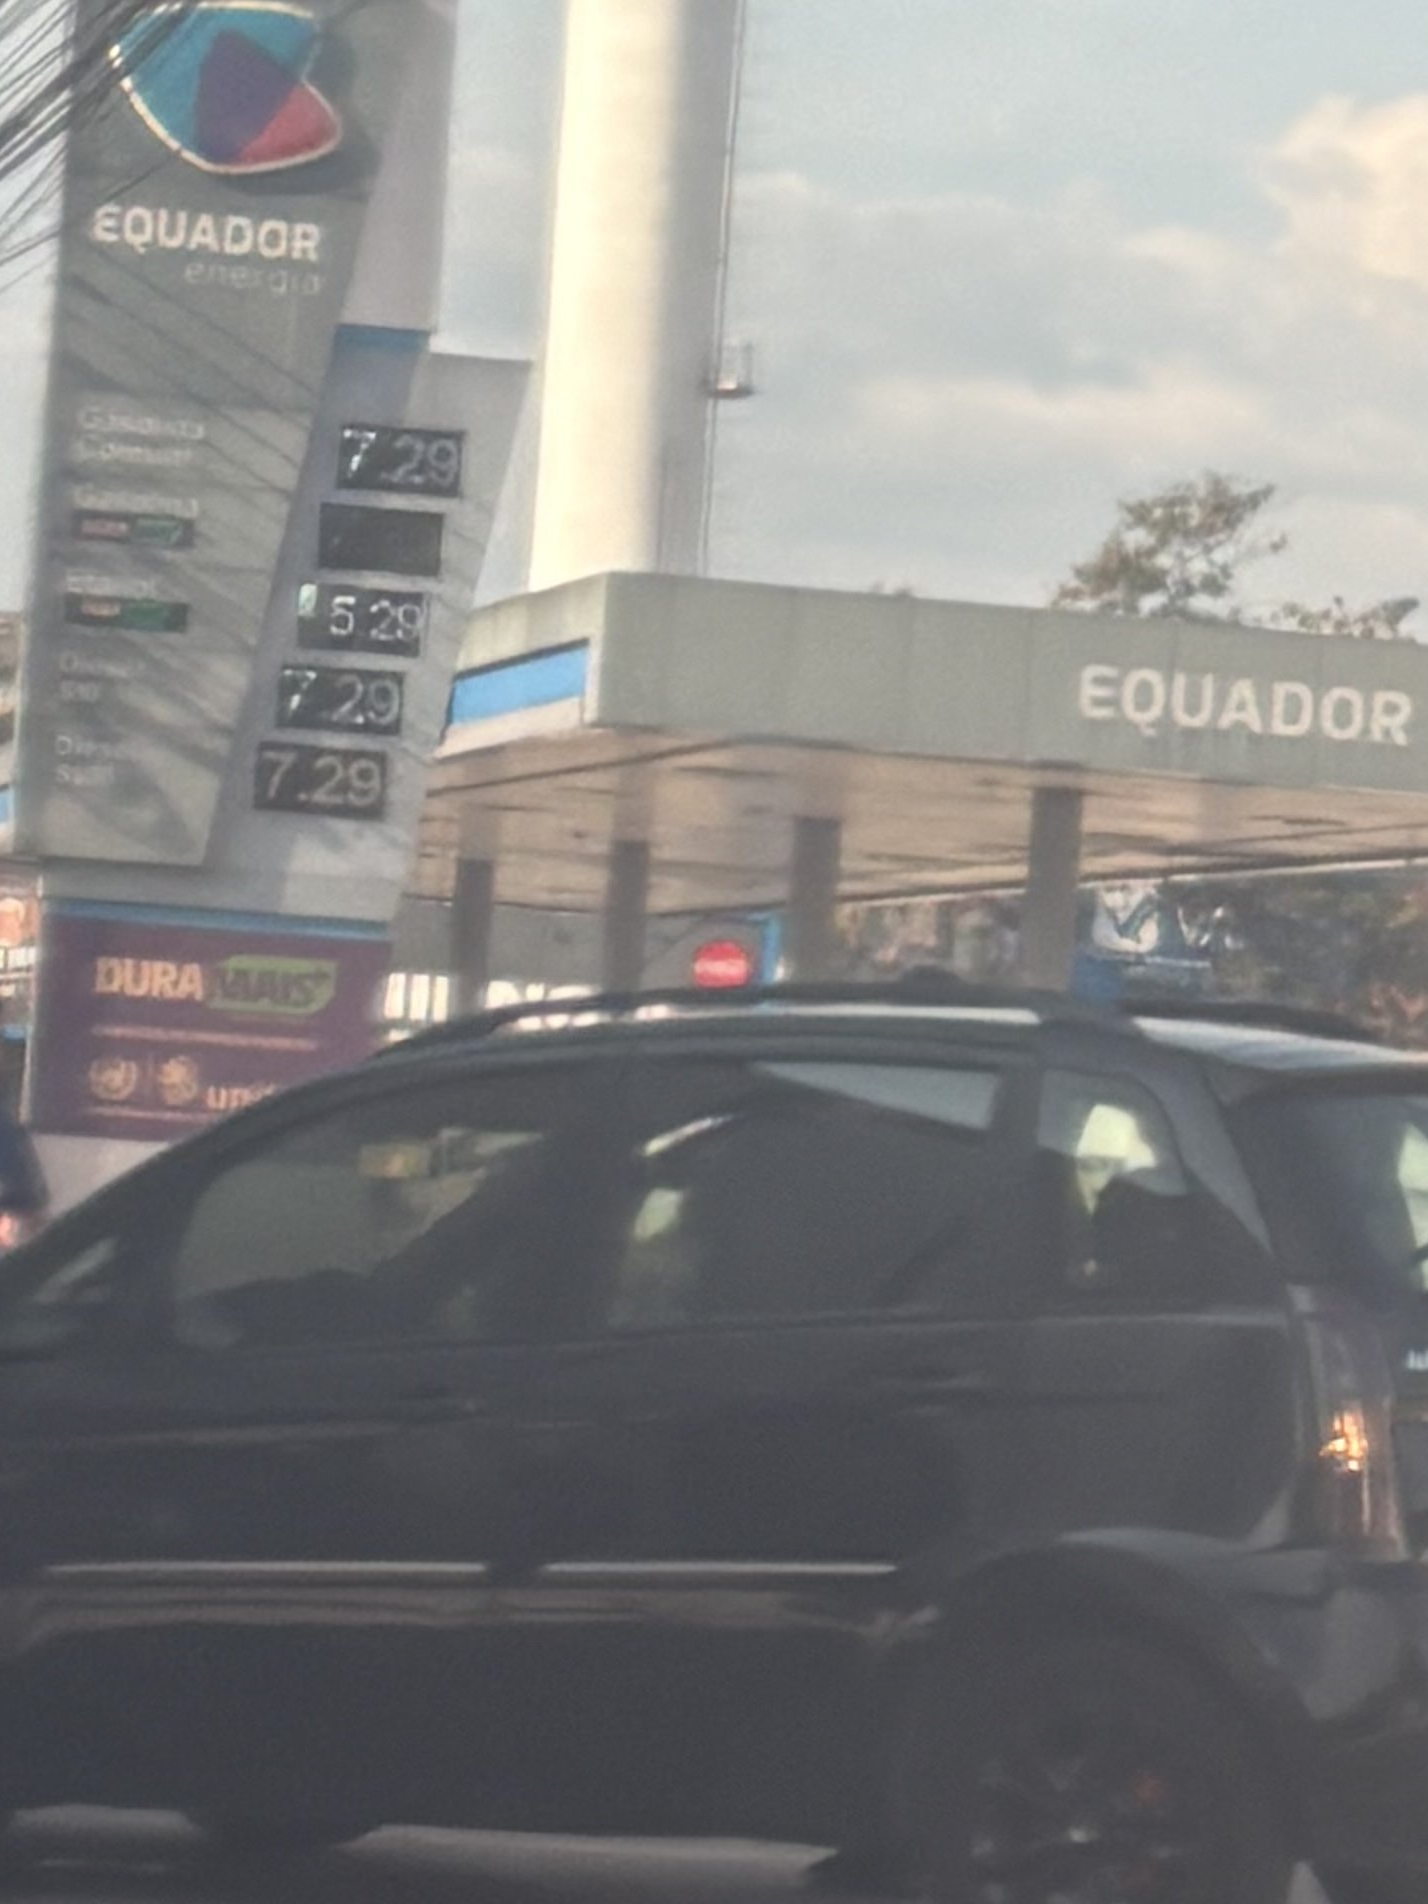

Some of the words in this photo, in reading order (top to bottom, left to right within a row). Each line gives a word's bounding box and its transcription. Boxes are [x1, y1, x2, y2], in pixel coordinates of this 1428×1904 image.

[92, 202, 322, 262] EQUADOR
[329, 595, 422, 642] 529
[1078, 663, 1413, 746] EQUADOR
[260, 750, 381, 808] 7.29
[95, 956, 204, 1001] DURA
